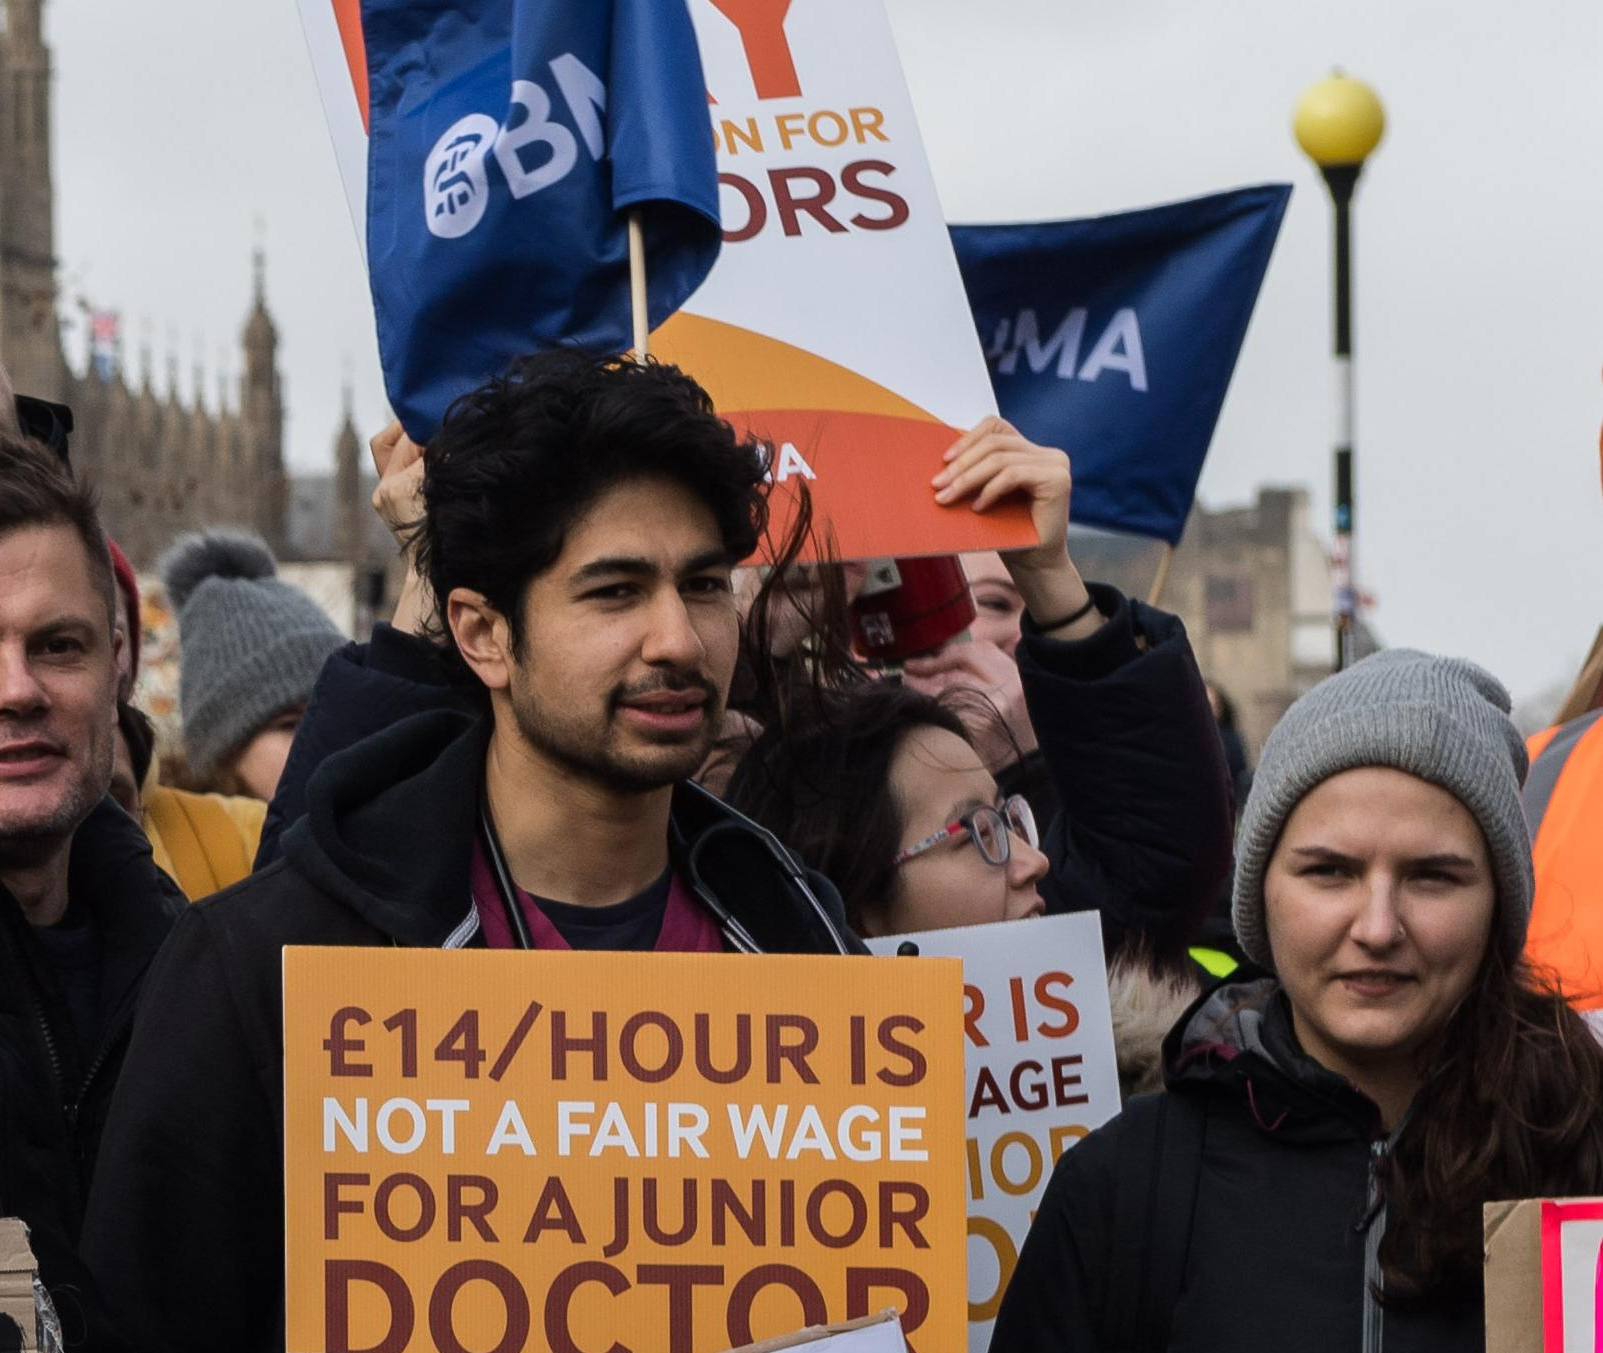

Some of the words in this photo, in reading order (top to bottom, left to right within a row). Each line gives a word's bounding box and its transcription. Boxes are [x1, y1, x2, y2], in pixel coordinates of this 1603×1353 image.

[774, 106, 890, 151] FOR
[984, 307, 1150, 393] MA
[1009, 971, 1080, 1043] IS
[322, 1001, 821, 1085] £14/HOUR
[850, 1014, 928, 1088] IS
[968, 1054, 1089, 1120] AGE
[322, 1097, 470, 1156] NOT
[486, 1100, 539, 1157] A
[557, 1101, 711, 1160] FAIR
[727, 1104, 929, 1163] WAGE
[322, 1172, 500, 1243] FOR
[523, 1176, 588, 1245] A
[602, 1177, 932, 1258] JUNIOR
